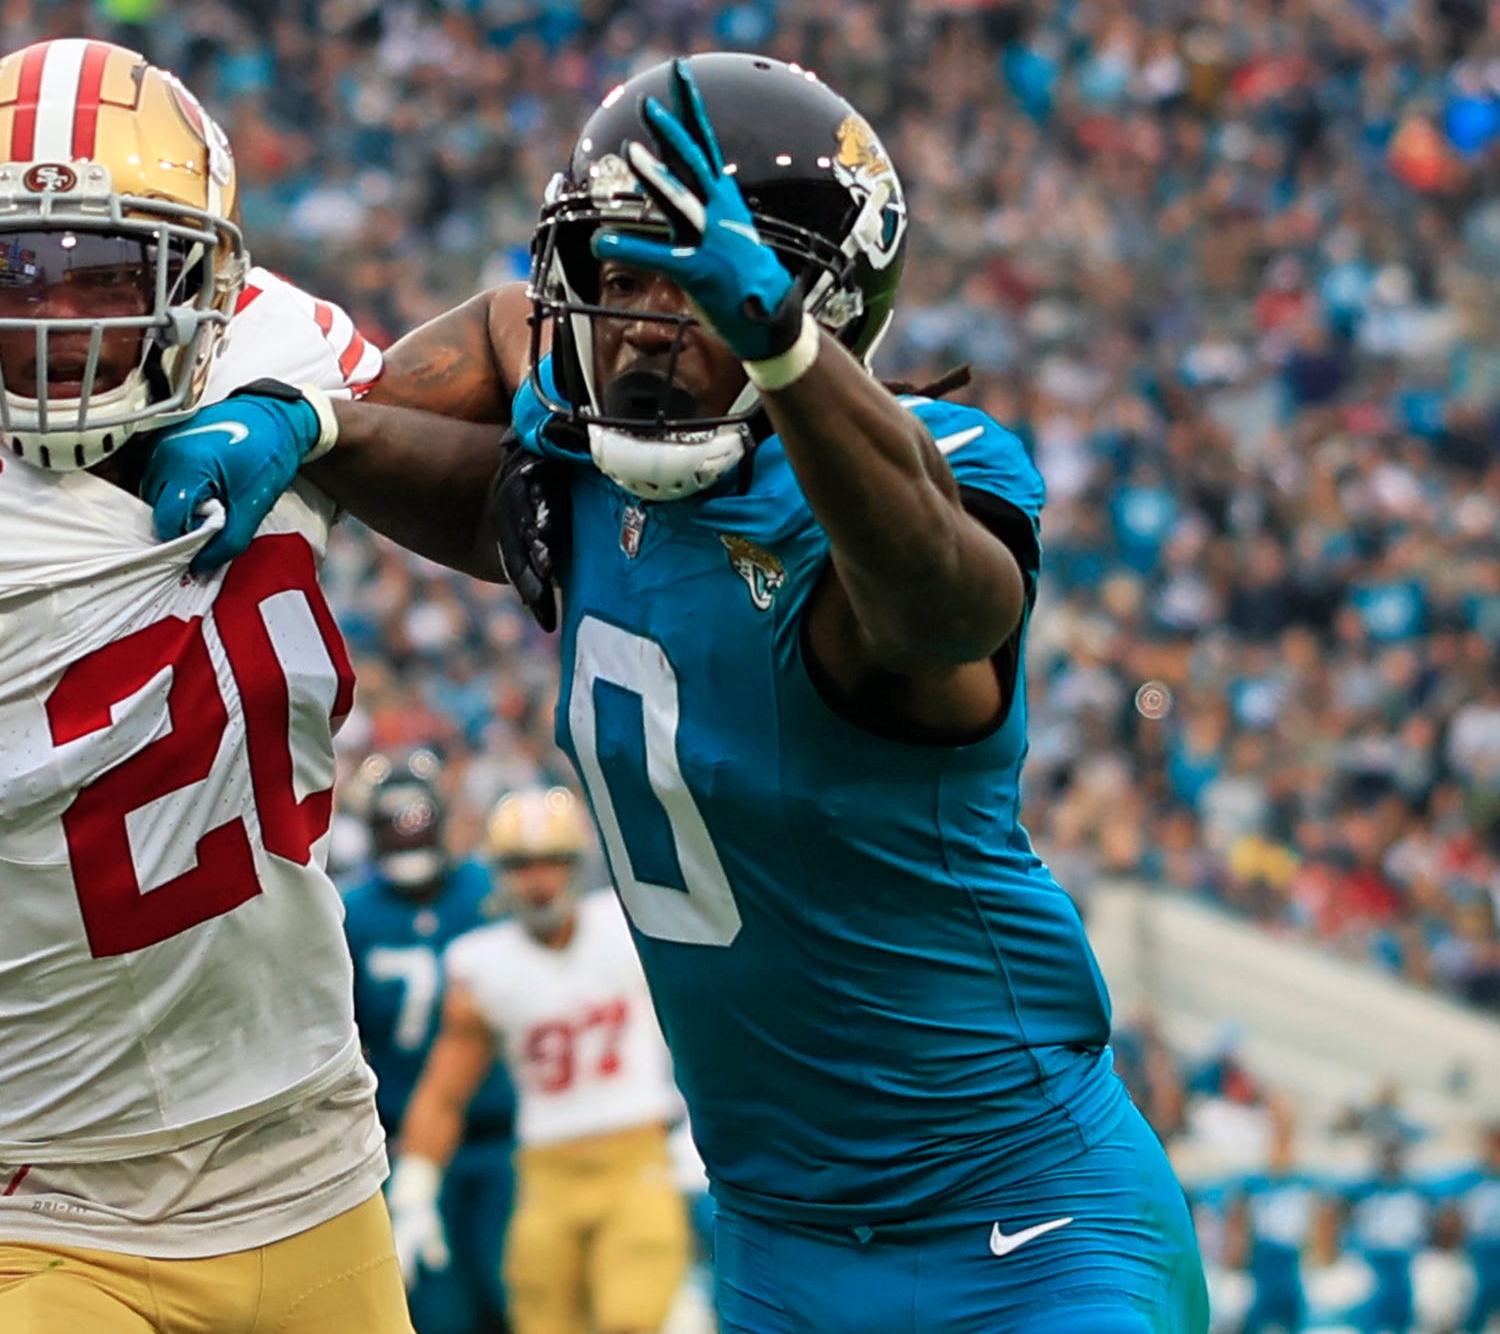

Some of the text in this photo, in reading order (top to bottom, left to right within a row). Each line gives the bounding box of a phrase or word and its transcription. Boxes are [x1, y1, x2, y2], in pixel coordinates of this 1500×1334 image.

[45, 531, 357, 959] 20
[569, 613, 744, 949] 0
[525, 996, 629, 1095] 97
